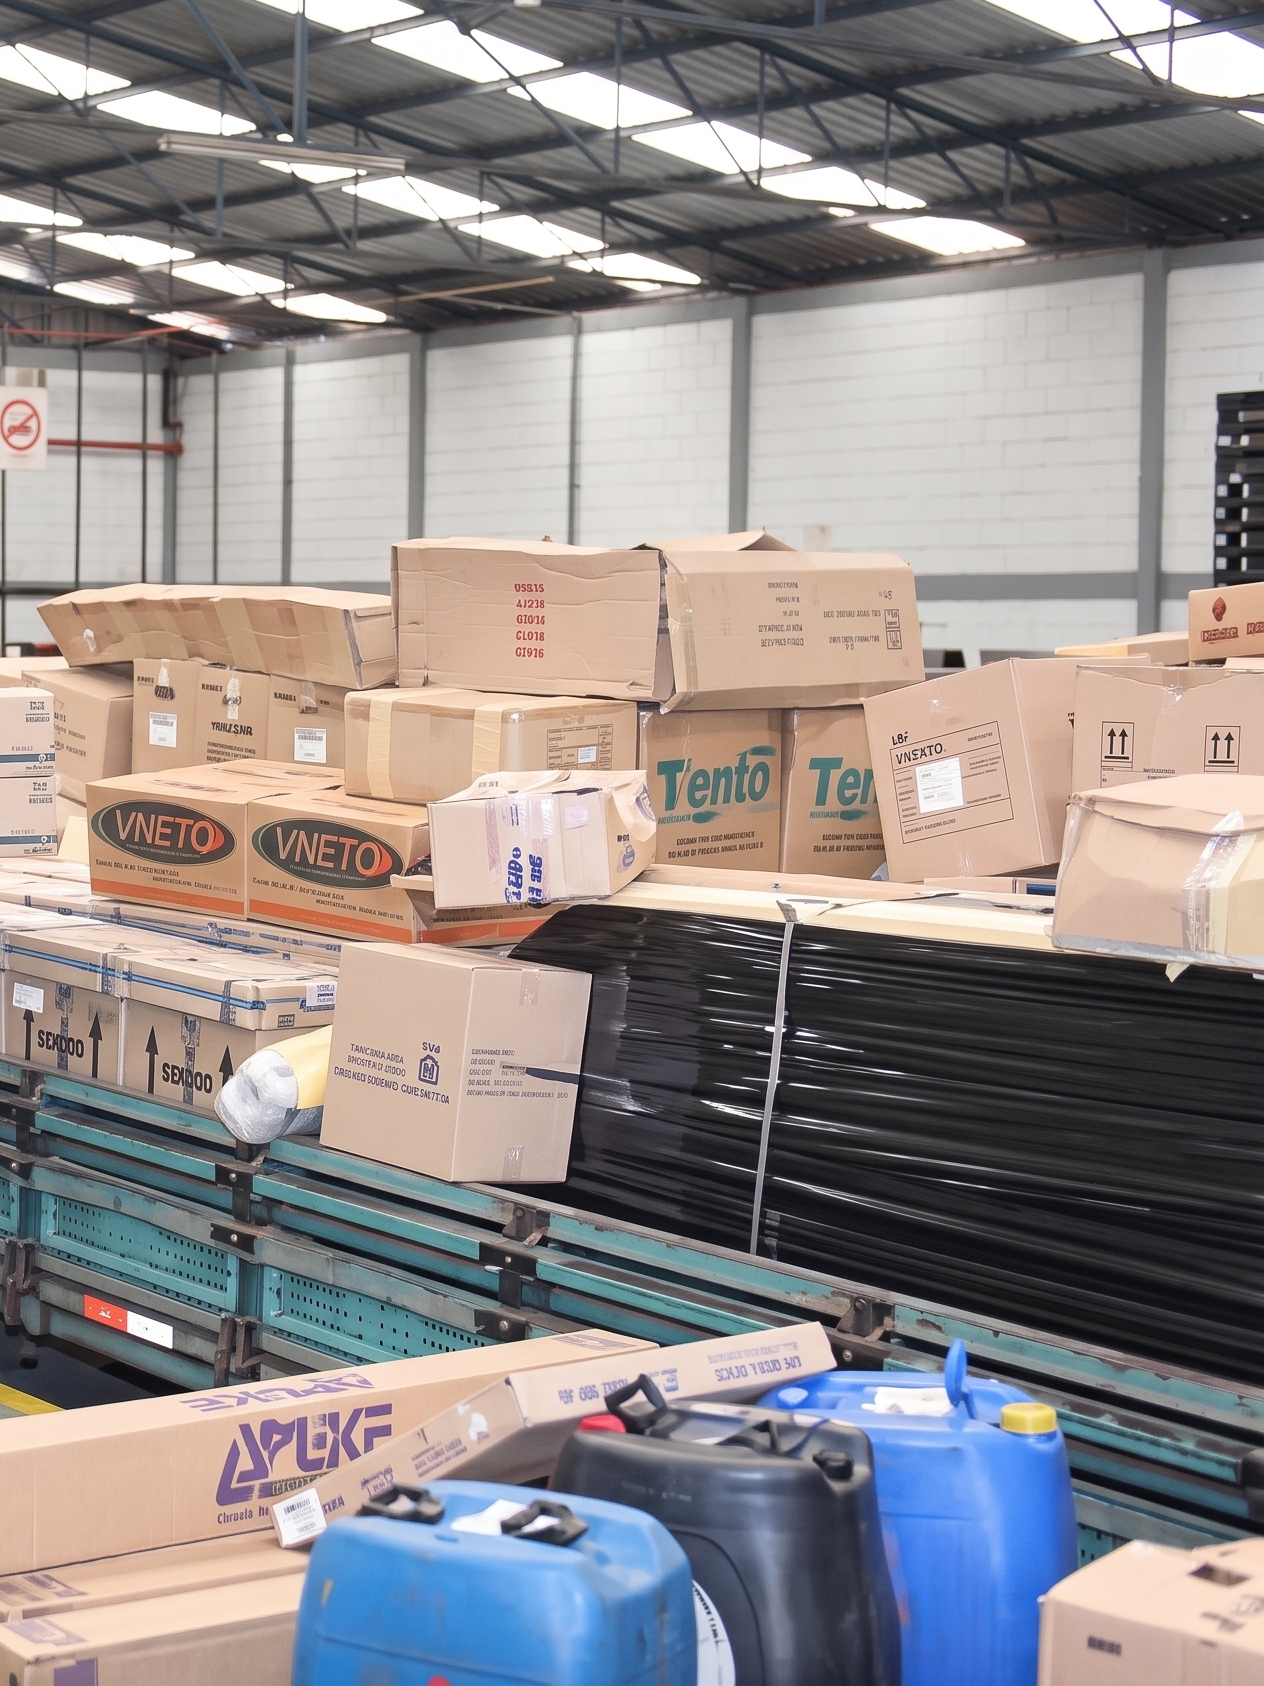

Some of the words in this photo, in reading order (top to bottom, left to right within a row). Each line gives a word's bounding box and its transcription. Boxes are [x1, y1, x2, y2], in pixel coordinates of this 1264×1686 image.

[657, 750, 772, 812] Tento
[115, 809, 216, 854] VNETO
[275, 826, 382, 877] VNETO
